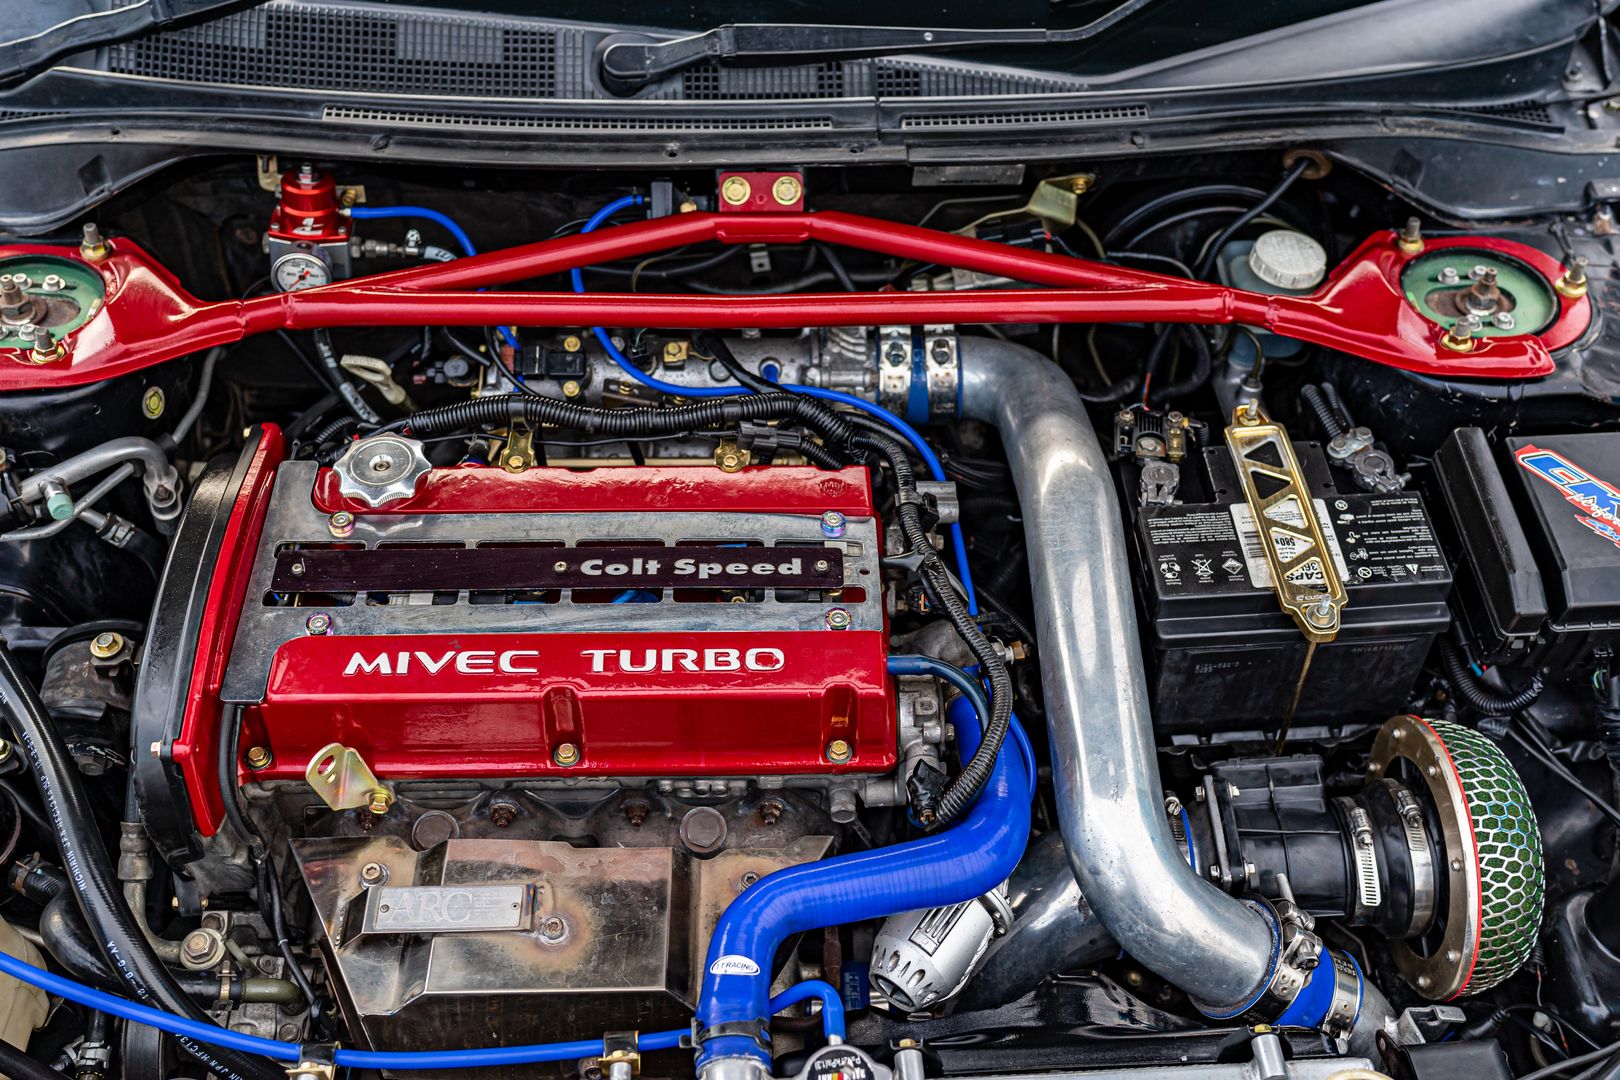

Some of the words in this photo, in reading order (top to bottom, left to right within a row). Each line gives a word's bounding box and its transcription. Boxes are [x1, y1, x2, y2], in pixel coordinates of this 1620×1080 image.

[580, 558, 661, 577] Colt
[673, 558, 802, 579] Speed
[342, 649, 540, 676] MIVEC
[580, 647, 785, 673] TURBO
[66, 850, 88, 891] NICHIRIN
[388, 891, 474, 923] ARC
[209, 1060, 229, 1074] JPN
